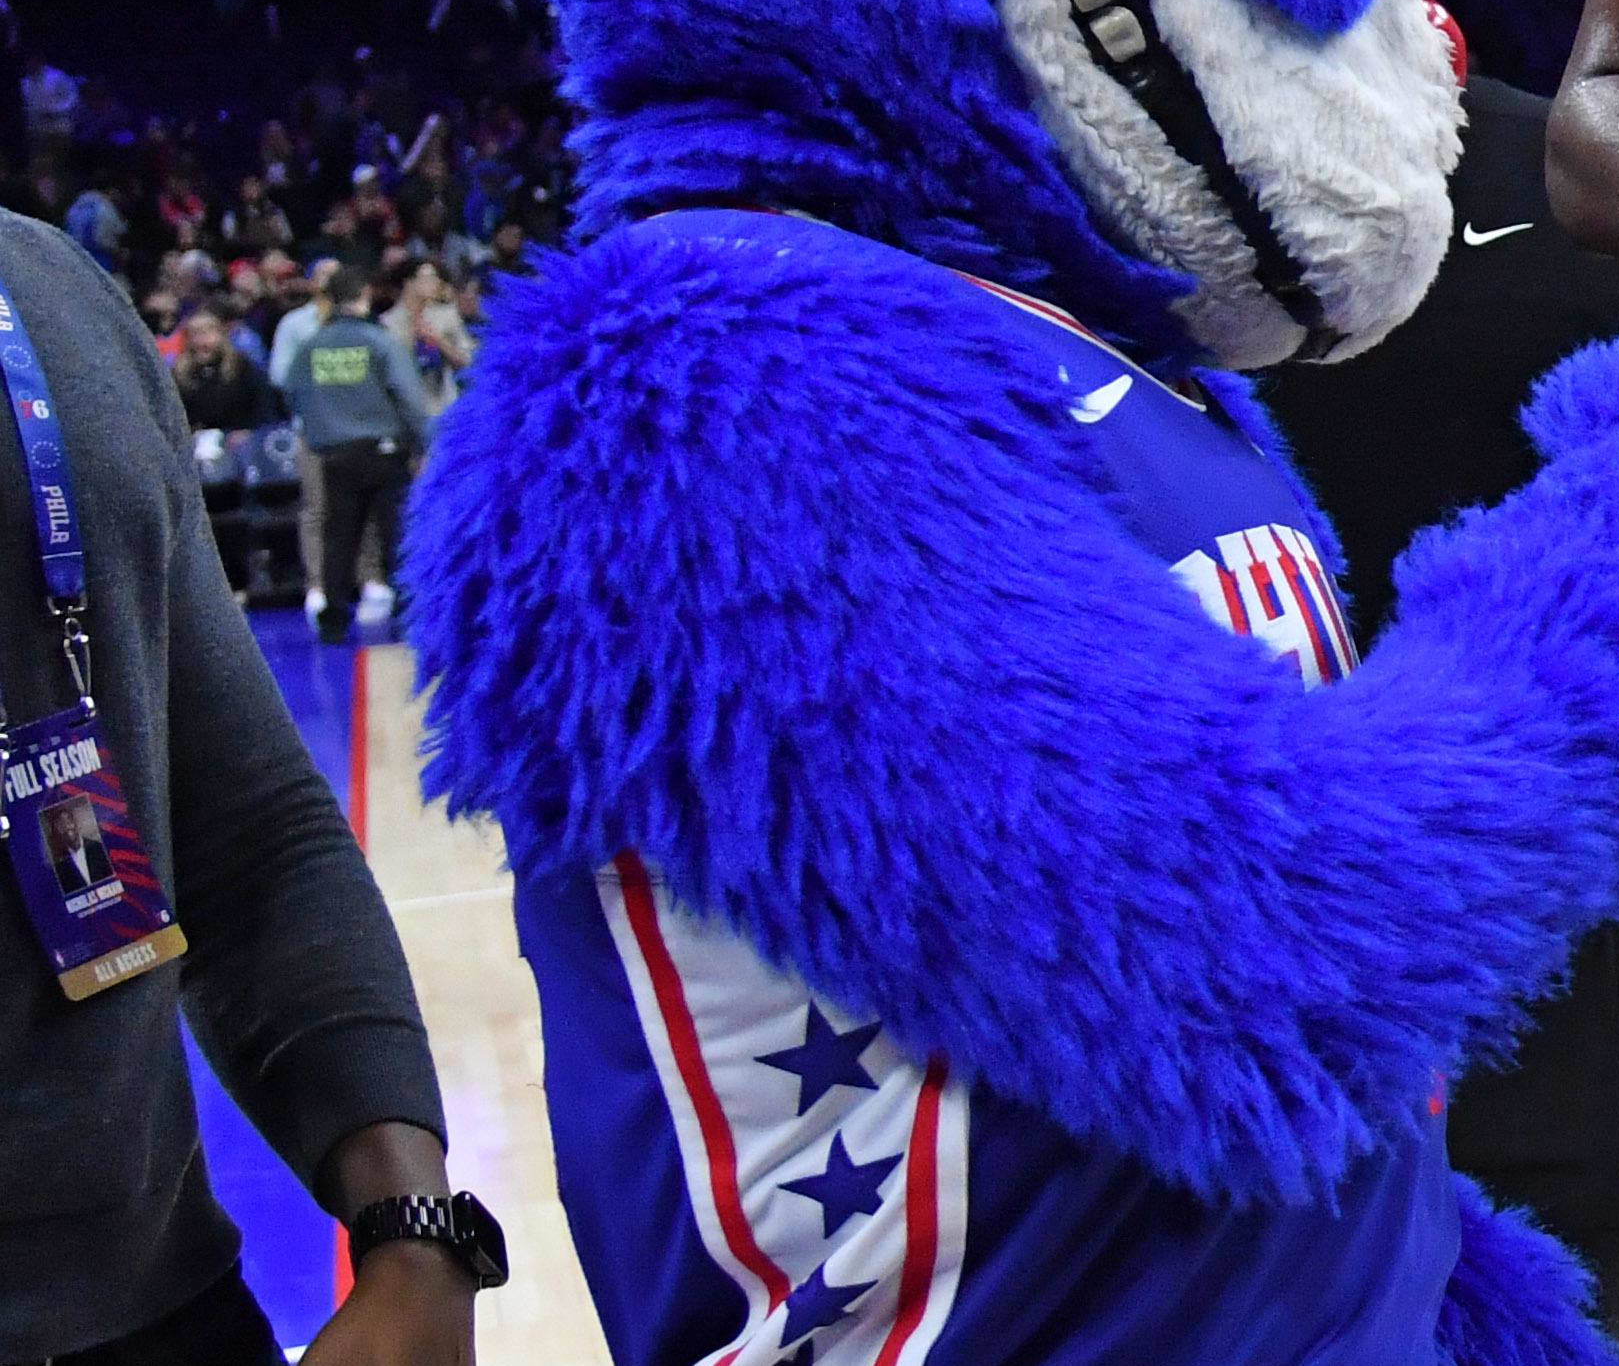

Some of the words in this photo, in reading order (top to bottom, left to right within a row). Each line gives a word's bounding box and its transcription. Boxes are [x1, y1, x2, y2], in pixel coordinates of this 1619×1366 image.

[40, 484, 70, 544] PHILA
[6, 760, 42, 803] FULL
[39, 737, 103, 787] SEASON
